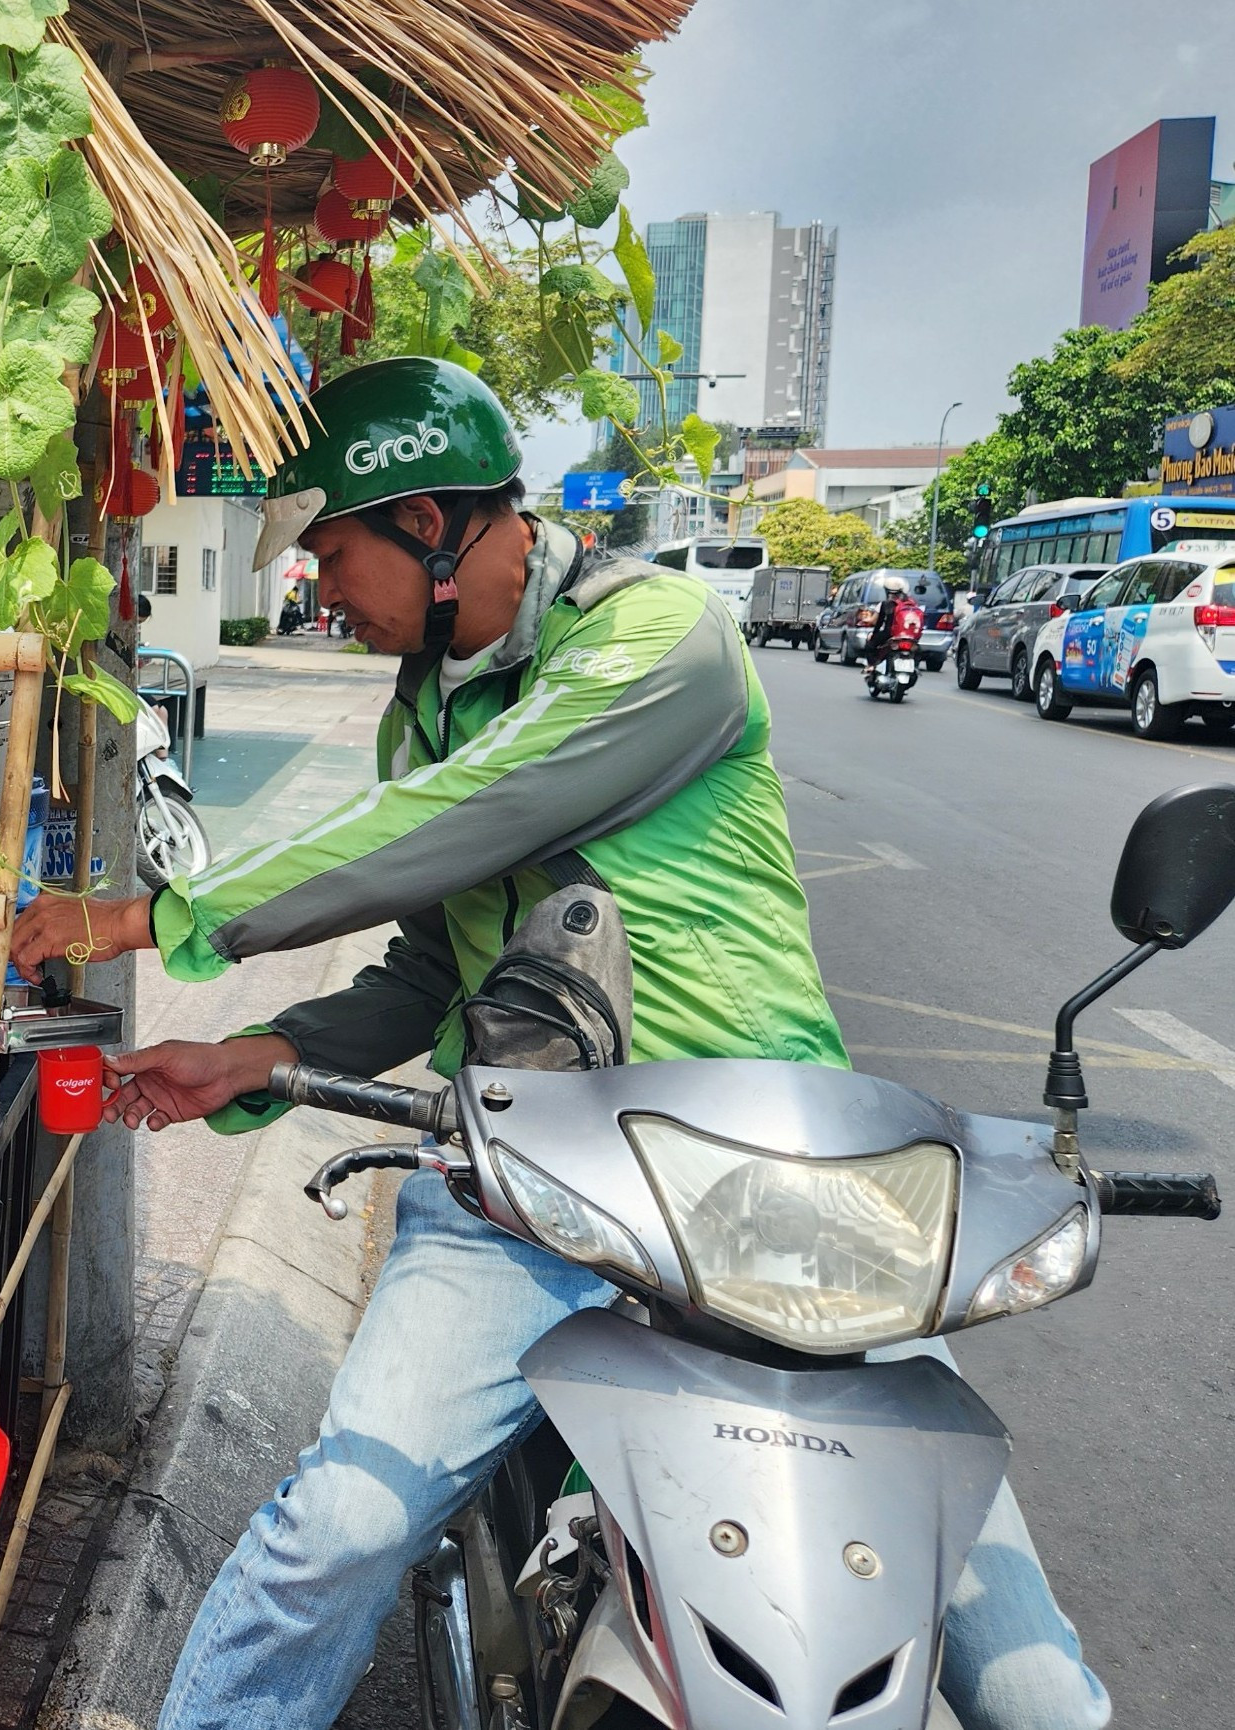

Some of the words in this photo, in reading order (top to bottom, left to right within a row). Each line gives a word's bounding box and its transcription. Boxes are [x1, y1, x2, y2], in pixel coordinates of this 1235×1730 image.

[345, 421, 448, 476] Grab
[1213, 447, 1235, 476] Musi
[1157, 512, 1171, 529] 5
[541, 644, 635, 682] rab
[56, 1078, 94, 1088] Colgate
[713, 1423, 855, 1459] HONDA
